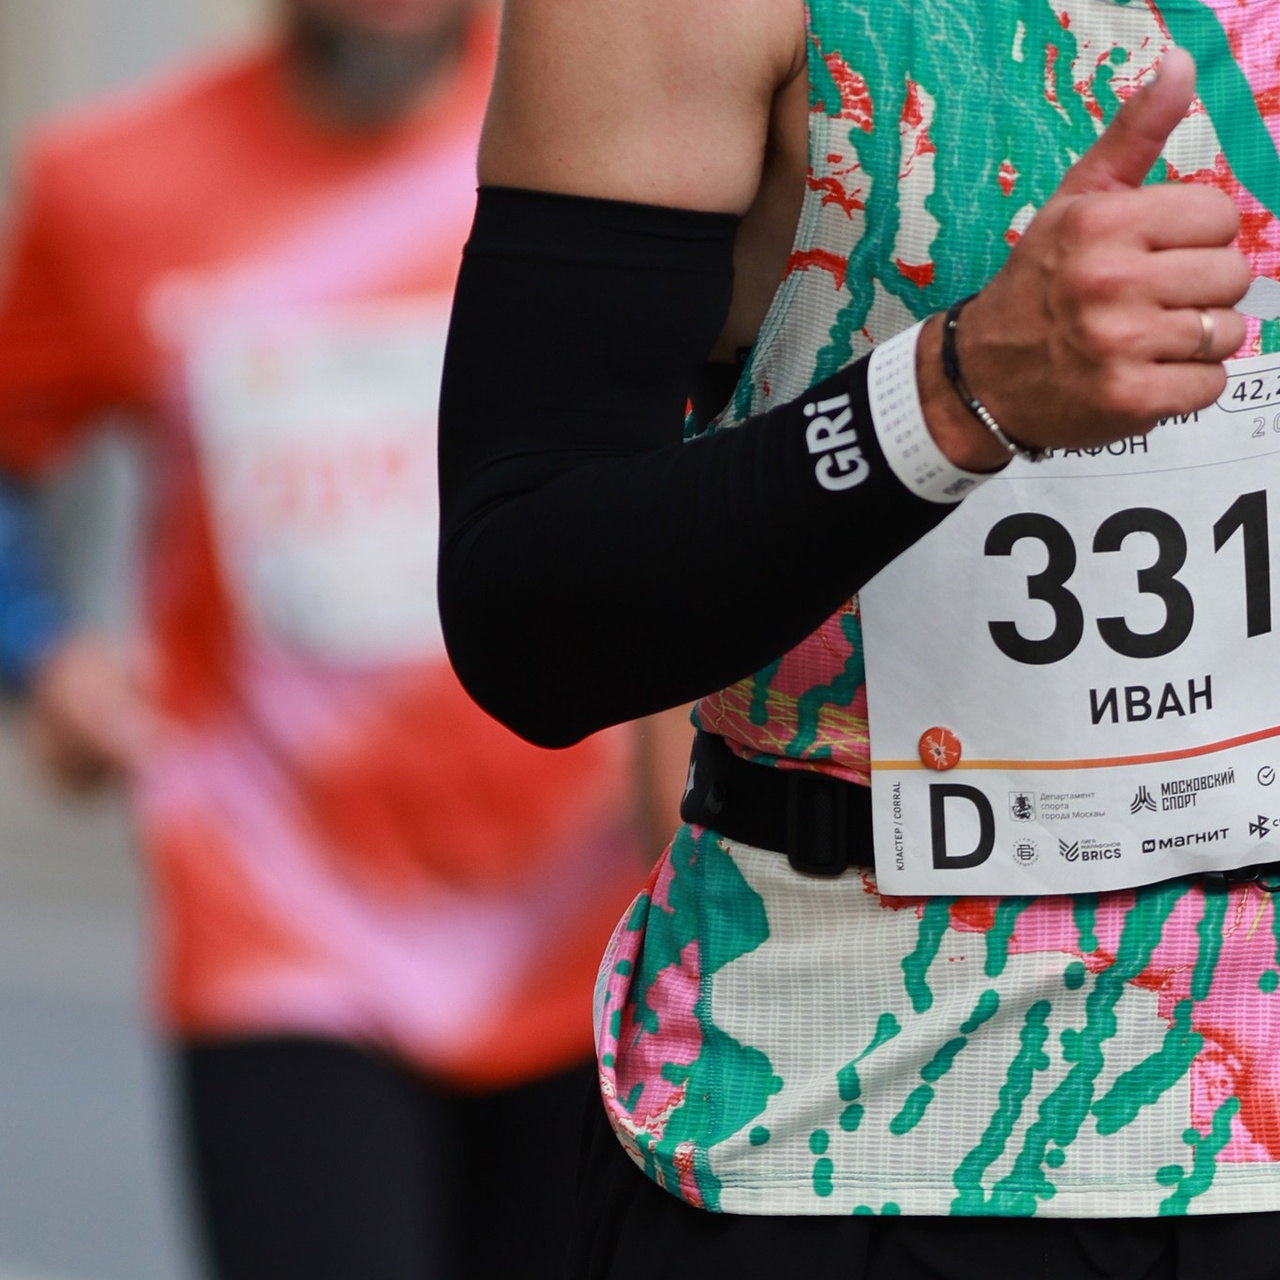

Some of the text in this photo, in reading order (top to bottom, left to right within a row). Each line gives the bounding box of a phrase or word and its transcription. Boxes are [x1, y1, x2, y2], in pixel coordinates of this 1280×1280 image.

[983, 488, 1273, 666] 331
[1088, 674, 1214, 725] ИВАН
[892, 780, 903, 820] CORRAL
[1039, 791, 1096, 802] Департамент
[1161, 768, 1236, 796] МОСКОВСКИЙ
[1161, 793, 1198, 812] СПОРТ
[929, 783, 996, 870] D
[894, 826, 905, 871] КЛАСТЕР
[1081, 848, 1122, 862] BRICS
